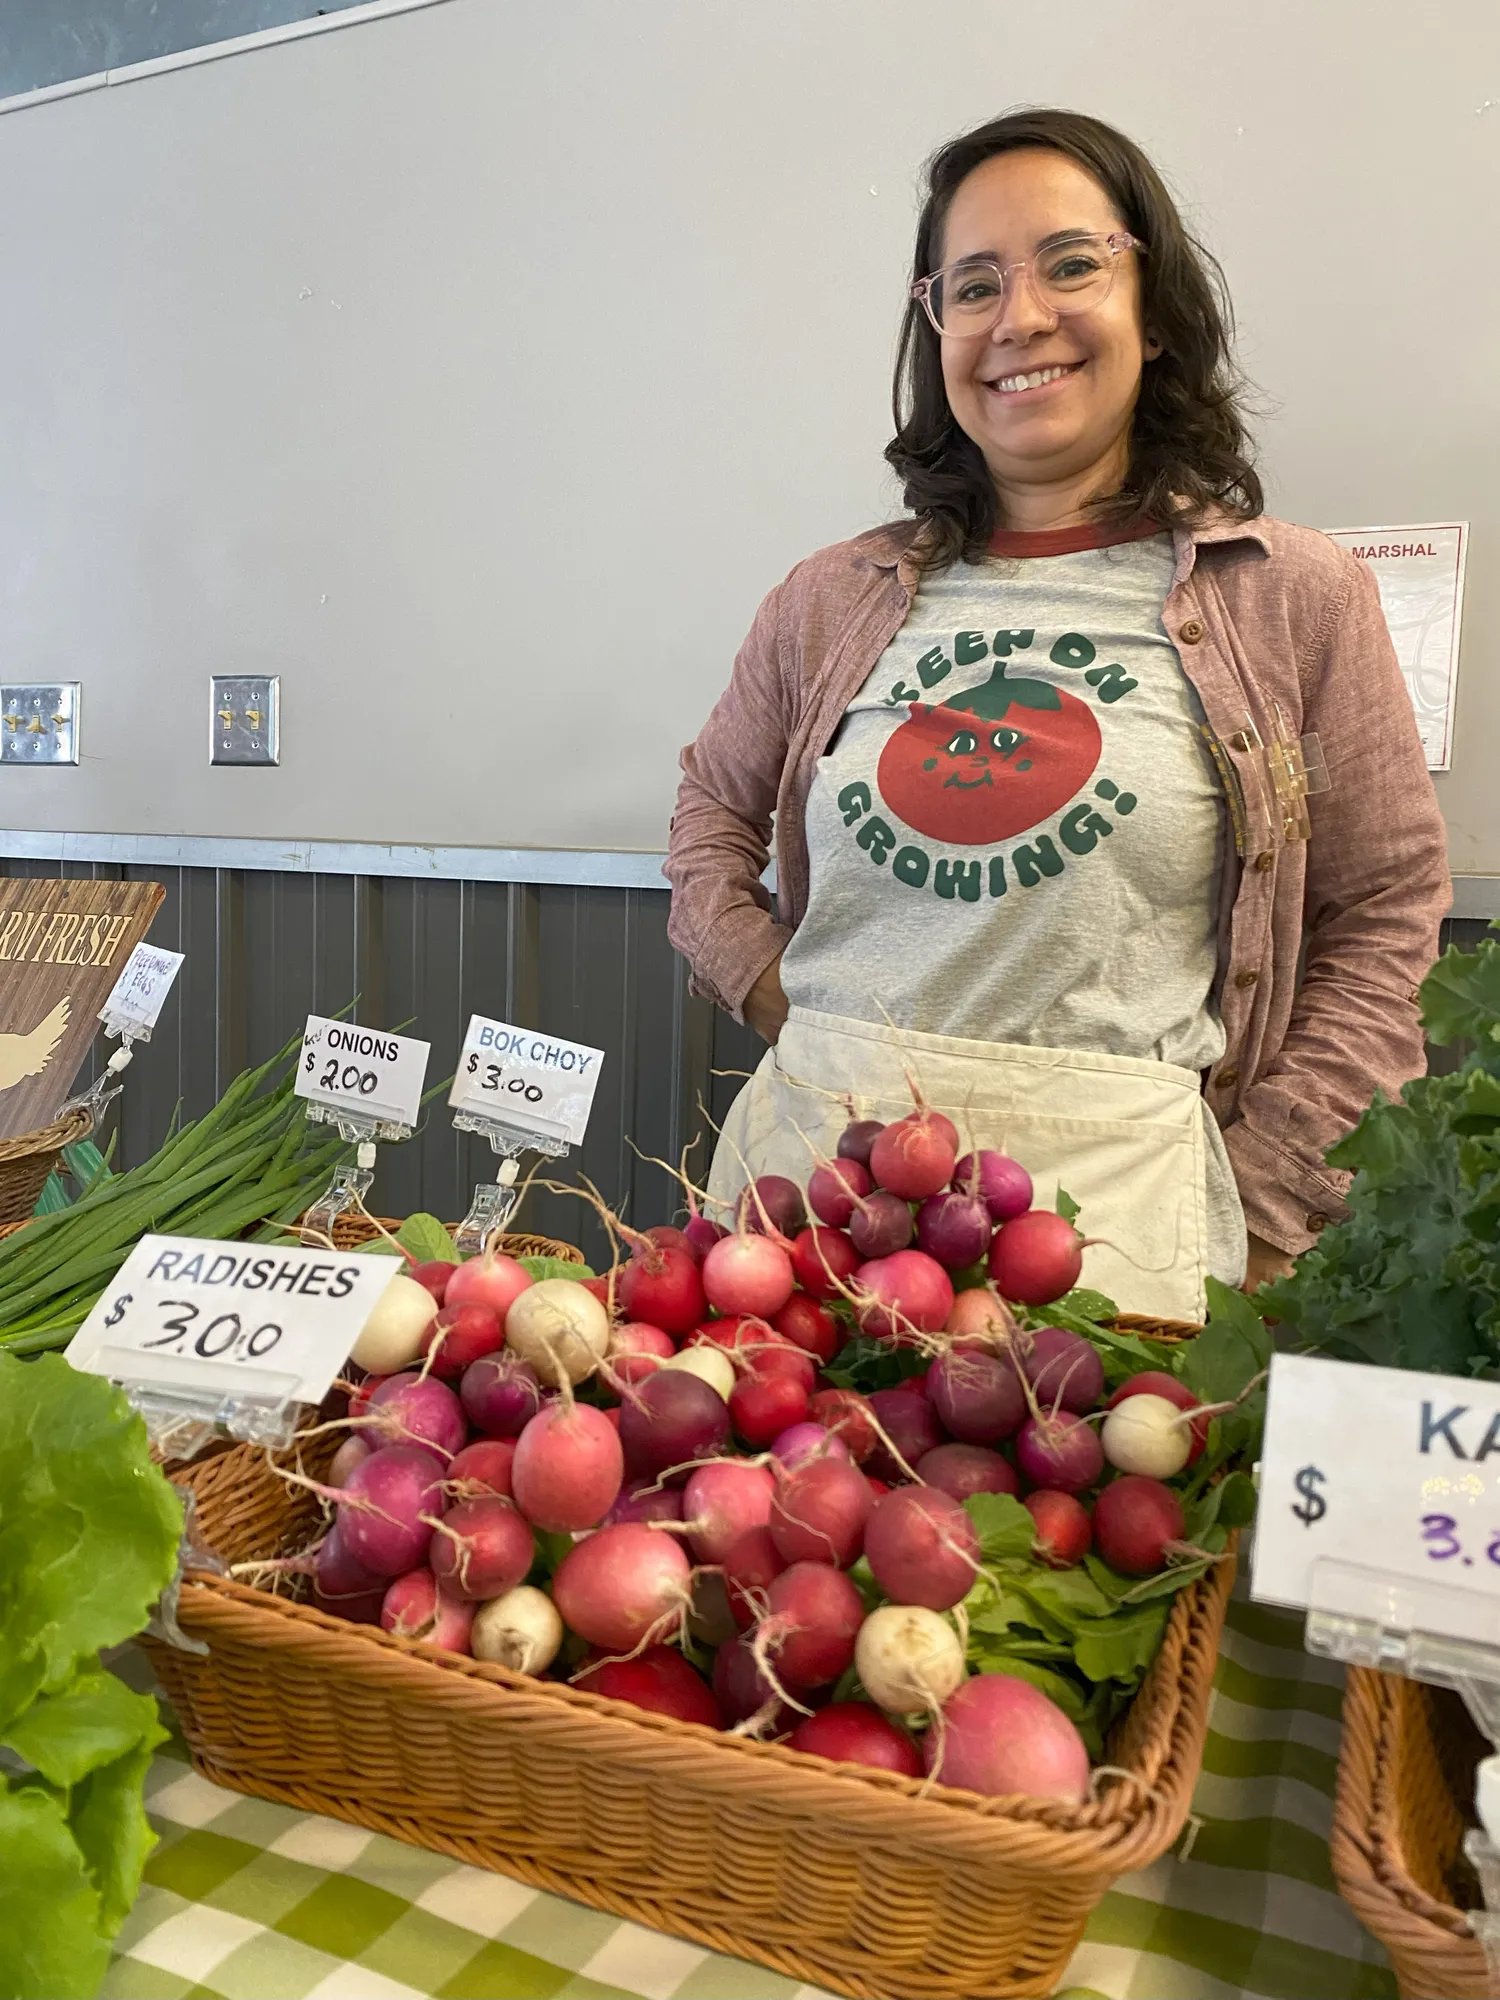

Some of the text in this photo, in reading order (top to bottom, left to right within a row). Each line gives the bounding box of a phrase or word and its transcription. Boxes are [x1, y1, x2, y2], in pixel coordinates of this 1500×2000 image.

[1352, 543, 1437, 559] MARSHAL
[1049, 632, 1139, 704] ON
[0, 910, 133, 967] RM FRESH
[327, 1029, 399, 1061] ONIONS
[479, 1026, 593, 1074] BOK CHOY
[305, 1052, 378, 1095] $ 2.00
[467, 1053, 543, 1102] $ 3.00
[147, 1250, 360, 1297] RADISHES
[104, 1294, 283, 1361] $ 3.00
[1291, 1465, 1328, 1528] $
